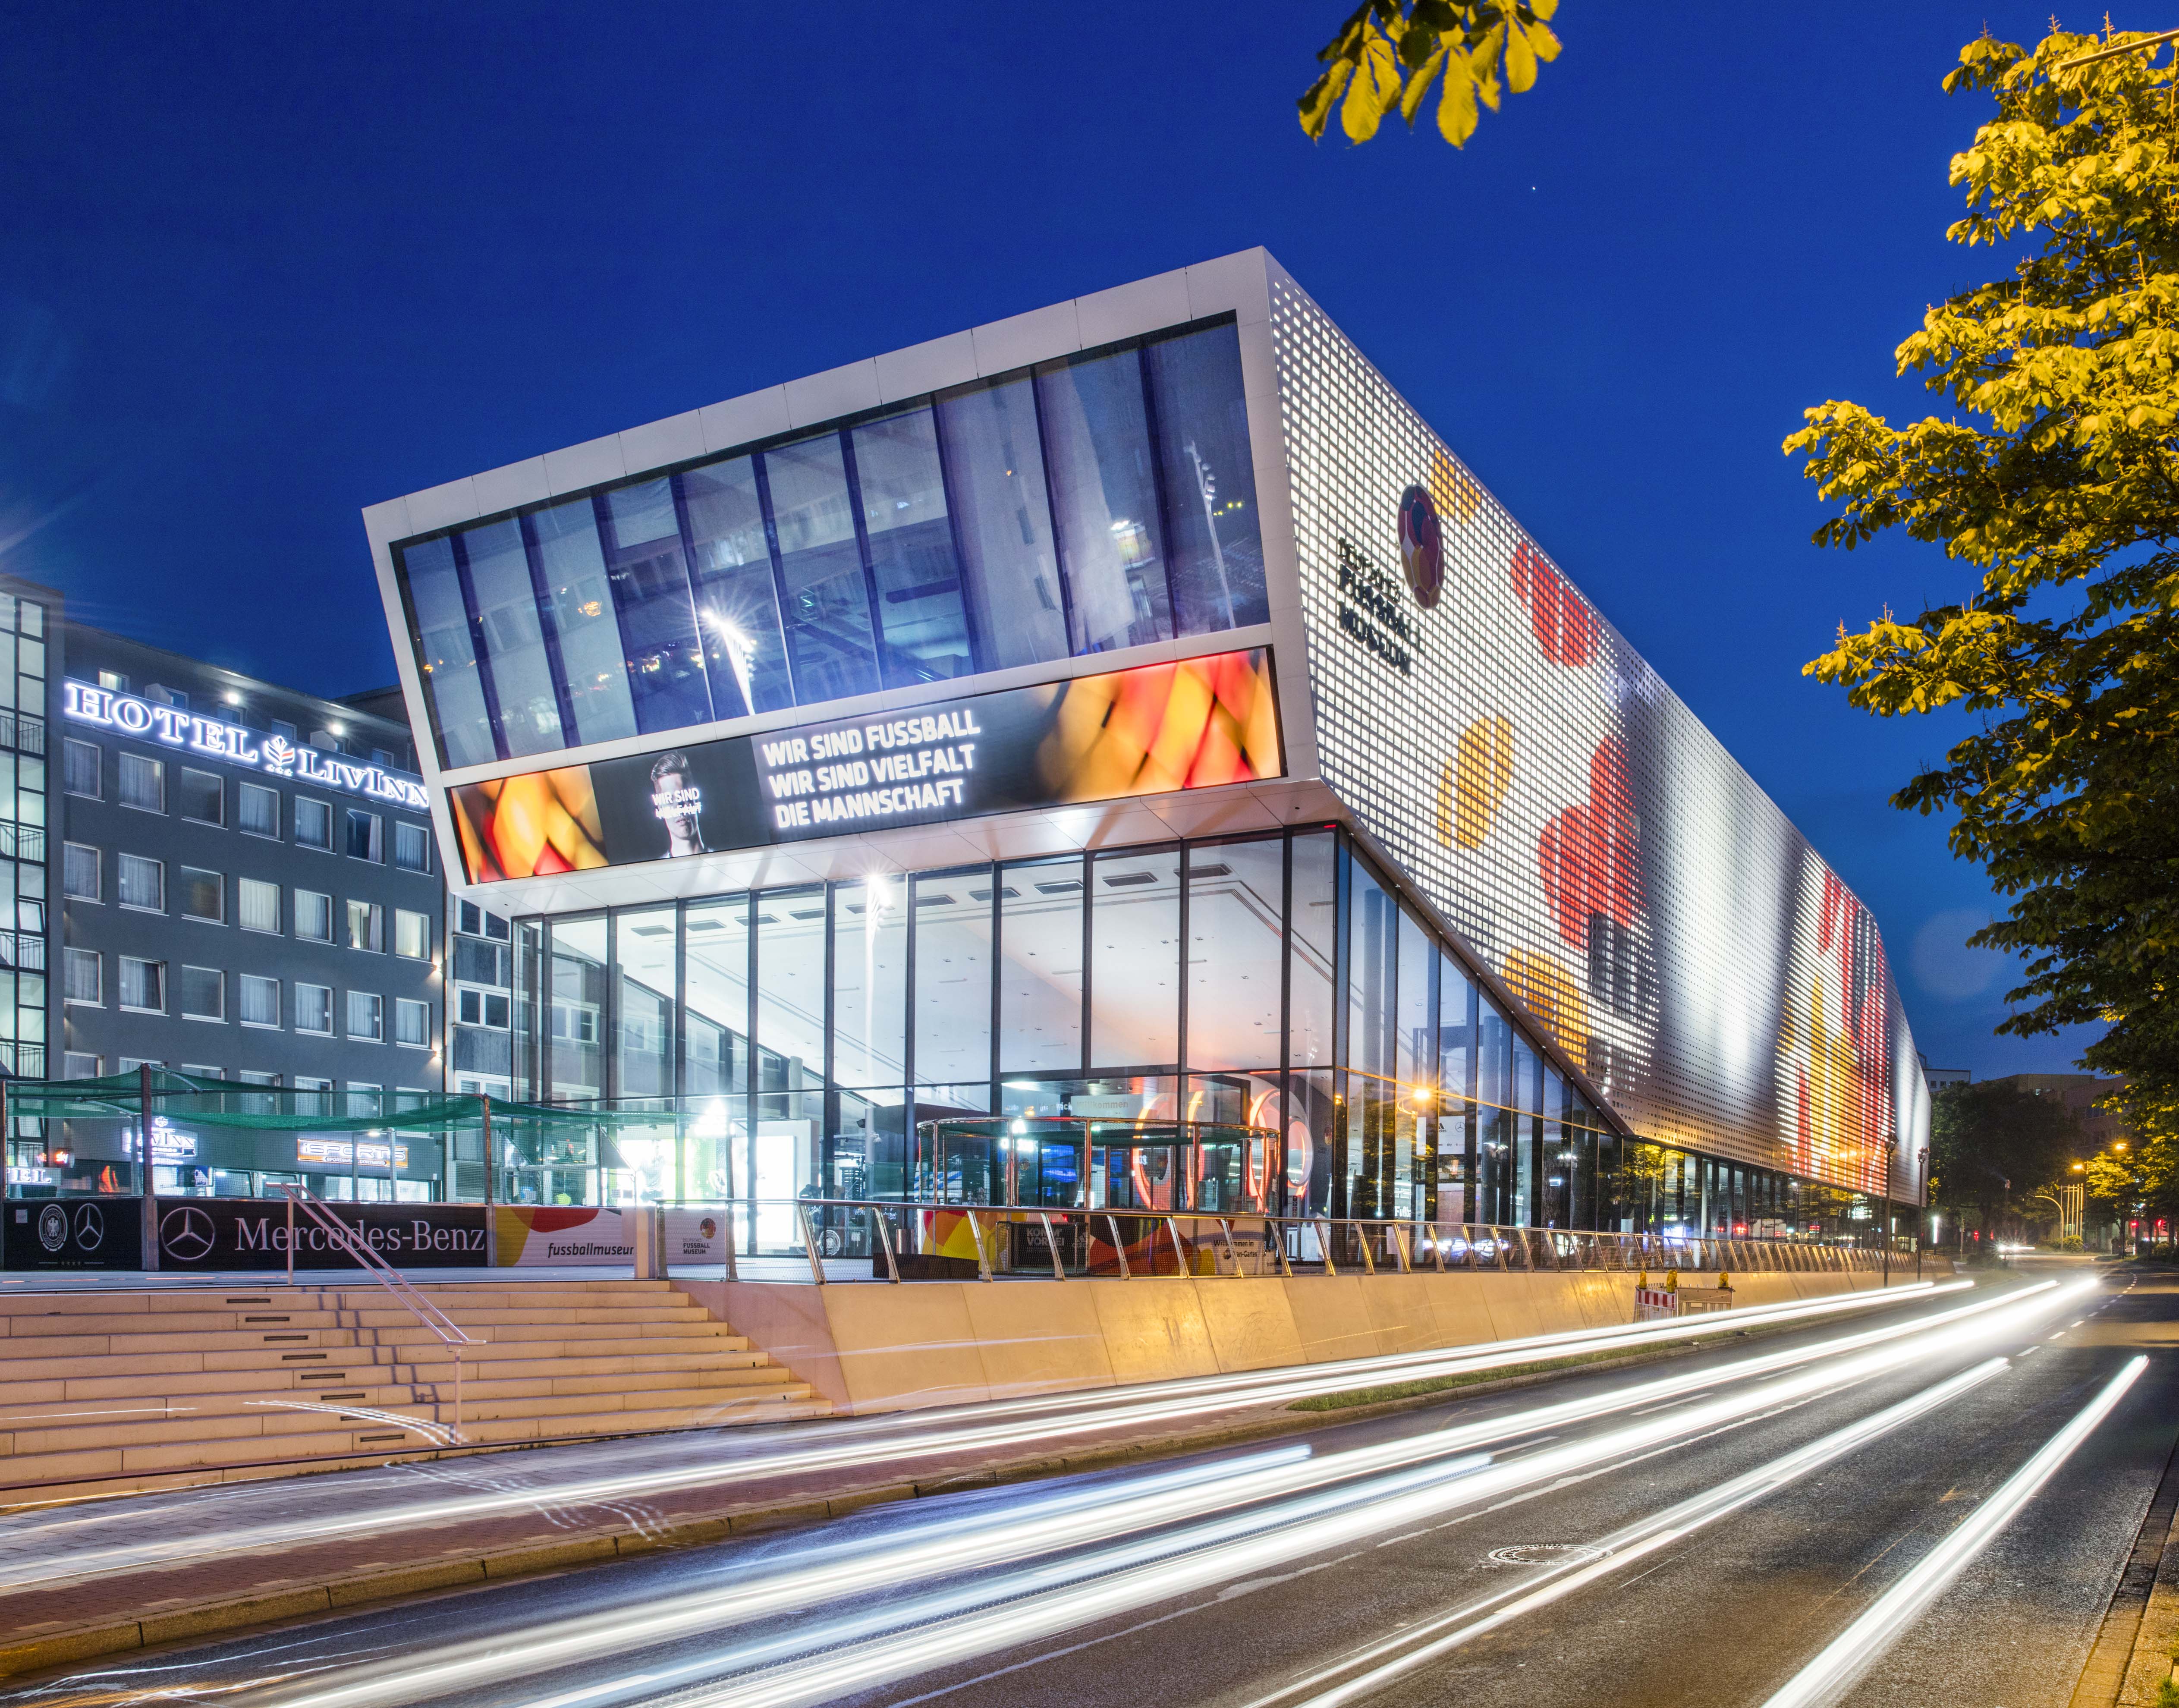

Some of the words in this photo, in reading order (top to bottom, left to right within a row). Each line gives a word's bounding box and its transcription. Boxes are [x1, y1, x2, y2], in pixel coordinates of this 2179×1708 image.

[1338, 563, 1425, 656] FUSSBALL
[1338, 600, 1411, 677] MUSEUM
[66, 683, 258, 762] HOTEL
[762, 739, 810, 767] WIR
[811, 729, 863, 759] SIND
[865, 710, 981, 750] FUSSBALL
[652, 792, 673, 805] WIR
[674, 788, 700, 802] SIND
[769, 770, 815, 798] WIR
[817, 762, 868, 791] SIND
[871, 744, 975, 783] VIELFALT
[775, 801, 810, 828] DIE
[812, 779, 963, 823] MANNSCHAFT
[234, 1217, 485, 1251] Mercedes-Benz
[1027, 1237, 1065, 1246] VOREI
